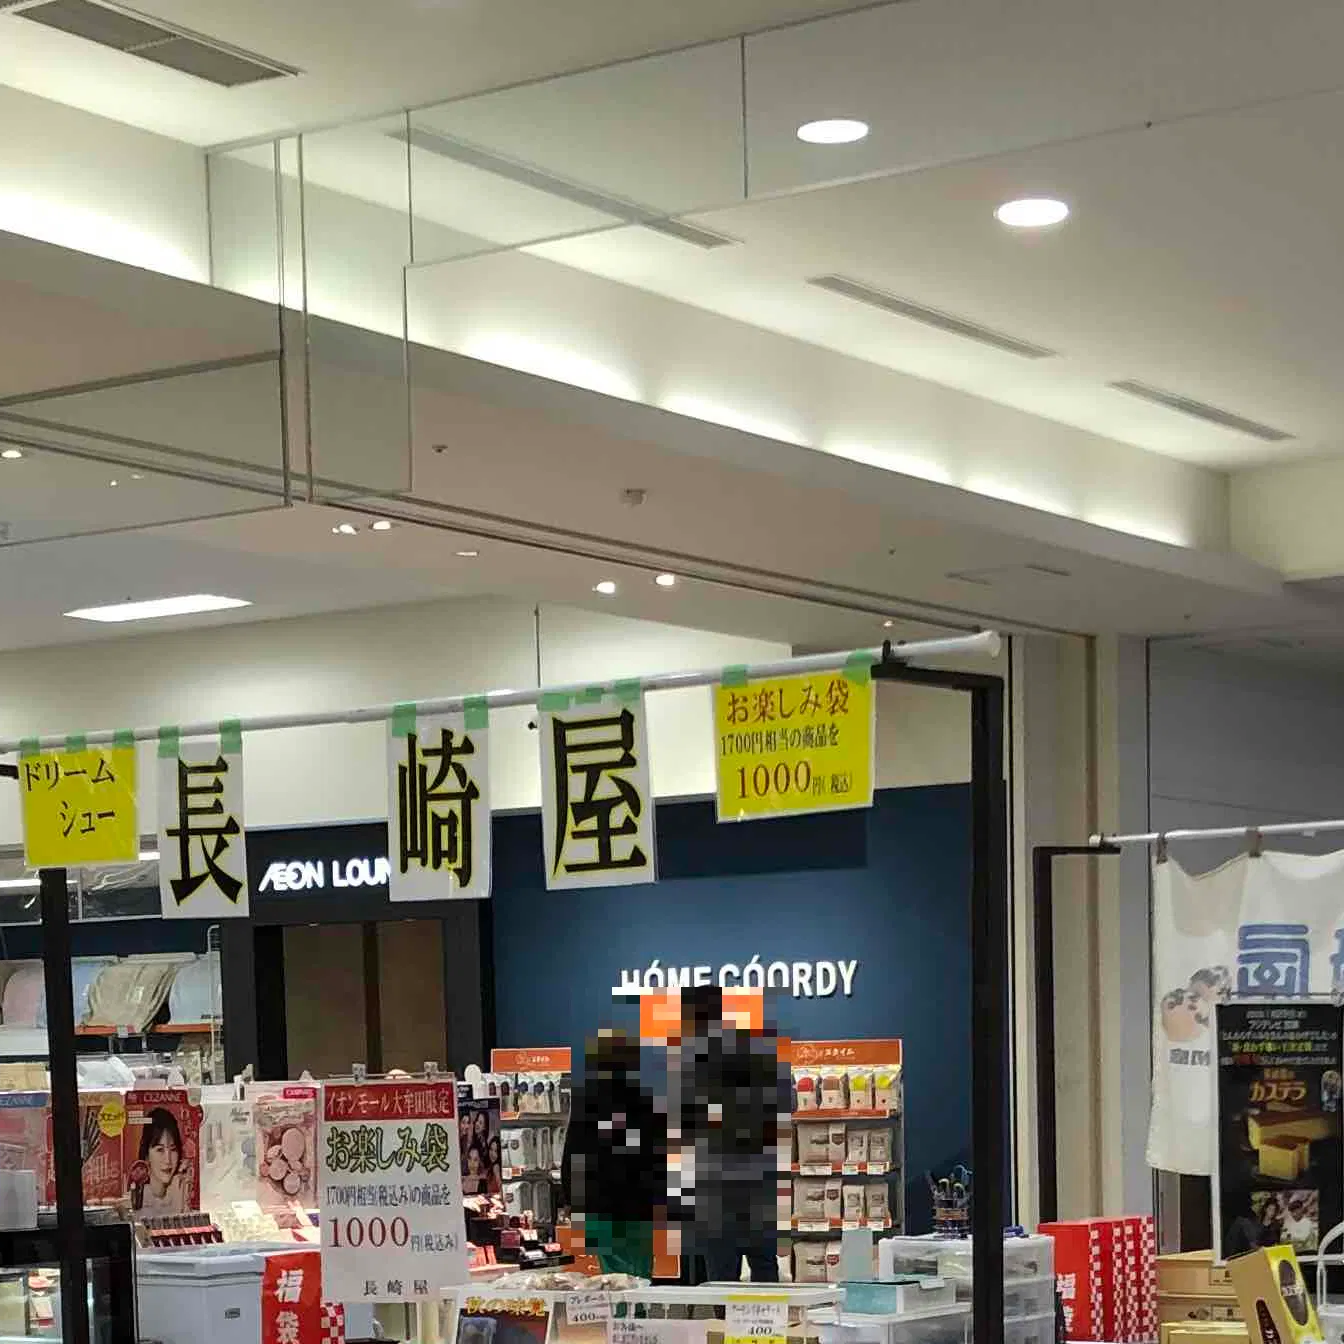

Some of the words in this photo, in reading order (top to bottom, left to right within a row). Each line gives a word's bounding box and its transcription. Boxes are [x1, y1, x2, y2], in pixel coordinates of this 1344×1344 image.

[727, 679, 849, 724] お楽しみ袋
[25, 758, 115, 792] ドリーム
[60, 800, 115, 838] シュー
[327, 1087, 451, 1119] イオンモール大牟田限定
[326, 1123, 450, 1173] お楽しみ袋
[275, 1268, 304, 1344] 福袋
